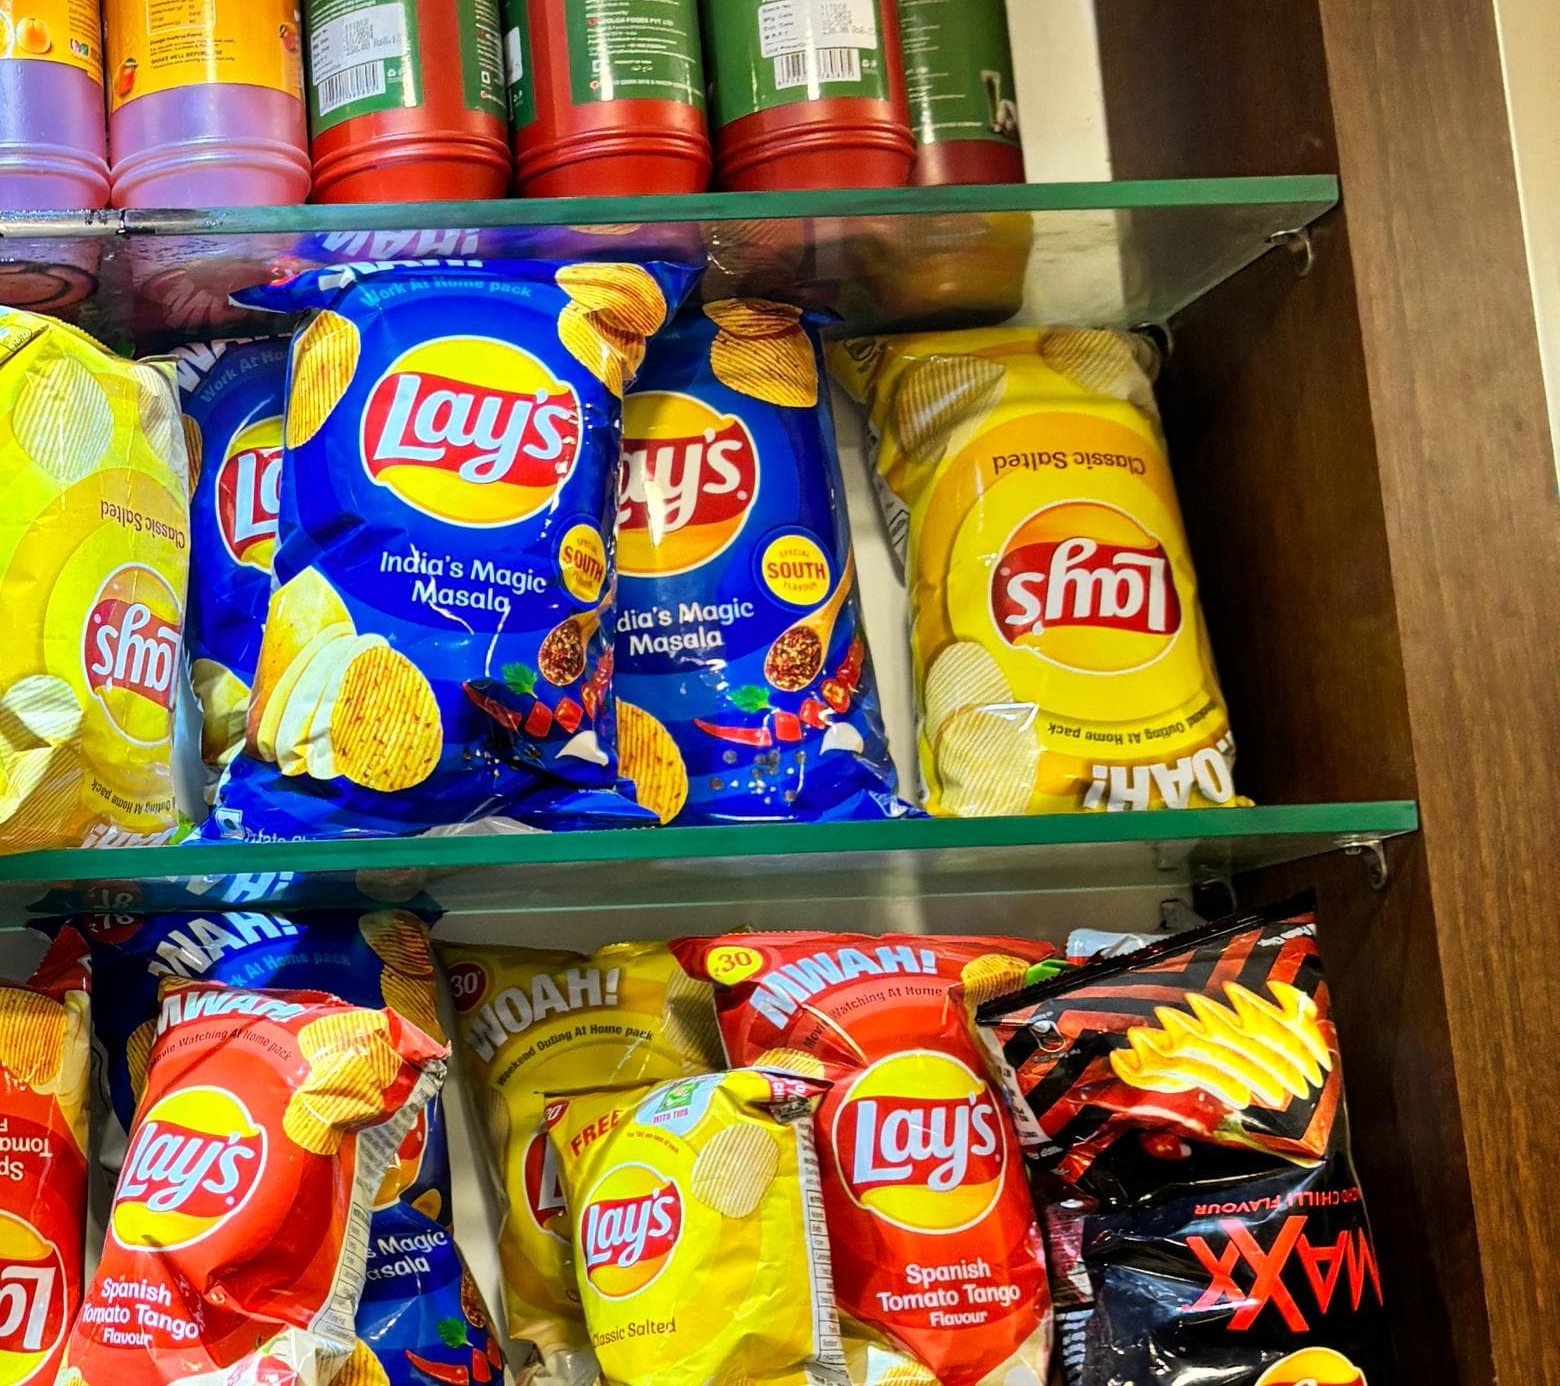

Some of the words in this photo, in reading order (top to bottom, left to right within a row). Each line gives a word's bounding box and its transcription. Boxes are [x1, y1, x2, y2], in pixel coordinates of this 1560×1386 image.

[359, 281, 408, 308] Work
[439, 277, 485, 291] Home
[489, 281, 532, 298] pack
[373, 373, 573, 484] Lay's
[992, 451, 1069, 475] Salted
[1073, 451, 1147, 475] Classic
[99, 500, 144, 532] Salted
[145, 521, 186, 550] Classic
[380, 551, 464, 579] India's
[470, 560, 547, 595] Magic
[562, 545, 604, 582] SOUTH
[766, 561, 827, 581] SOUTH
[411, 579, 512, 613] Masala
[1004, 537, 1167, 636] Lay's
[678, 597, 755, 626] Magic
[629, 625, 724, 657] Masala
[1047, 721, 1082, 741] pack
[1084, 727, 1125, 746] Home
[749, 945, 938, 1031] MWAH!
[829, 988, 887, 1019] Watching
[887, 985, 904, 1000] At
[904, 984, 943, 998] Home
[465, 967, 622, 1064] WOAH!
[178, 1027, 229, 1048] Watching
[269, 1040, 293, 1063] pack
[536, 1029, 574, 1053] Outing
[574, 1025, 589, 1040] At
[589, 1022, 624, 1038] Home
[624, 1025, 654, 1044] pack
[851, 1093, 997, 1192] Lay's
[116, 1122, 256, 1213] Lay's
[1194, 1194, 1283, 1216] FLAVOUR
[376, 1227, 449, 1258] Magic
[585, 1186, 678, 1268] Lay's
[905, 1259, 992, 1287] Spanish
[1181, 1215, 1384, 1333] MAXX
[100, 1277, 173, 1308] Spanish
[877, 1288, 960, 1313] Tomato
[961, 1281, 1021, 1308] Tango
[81, 1302, 132, 1327] Tomato
[134, 1303, 200, 1343] Tango
[590, 1322, 626, 1351] Classic
[627, 1316, 678, 1339] Salted
[928, 1308, 989, 1327] Flavour
[102, 1327, 154, 1348] Flavour
